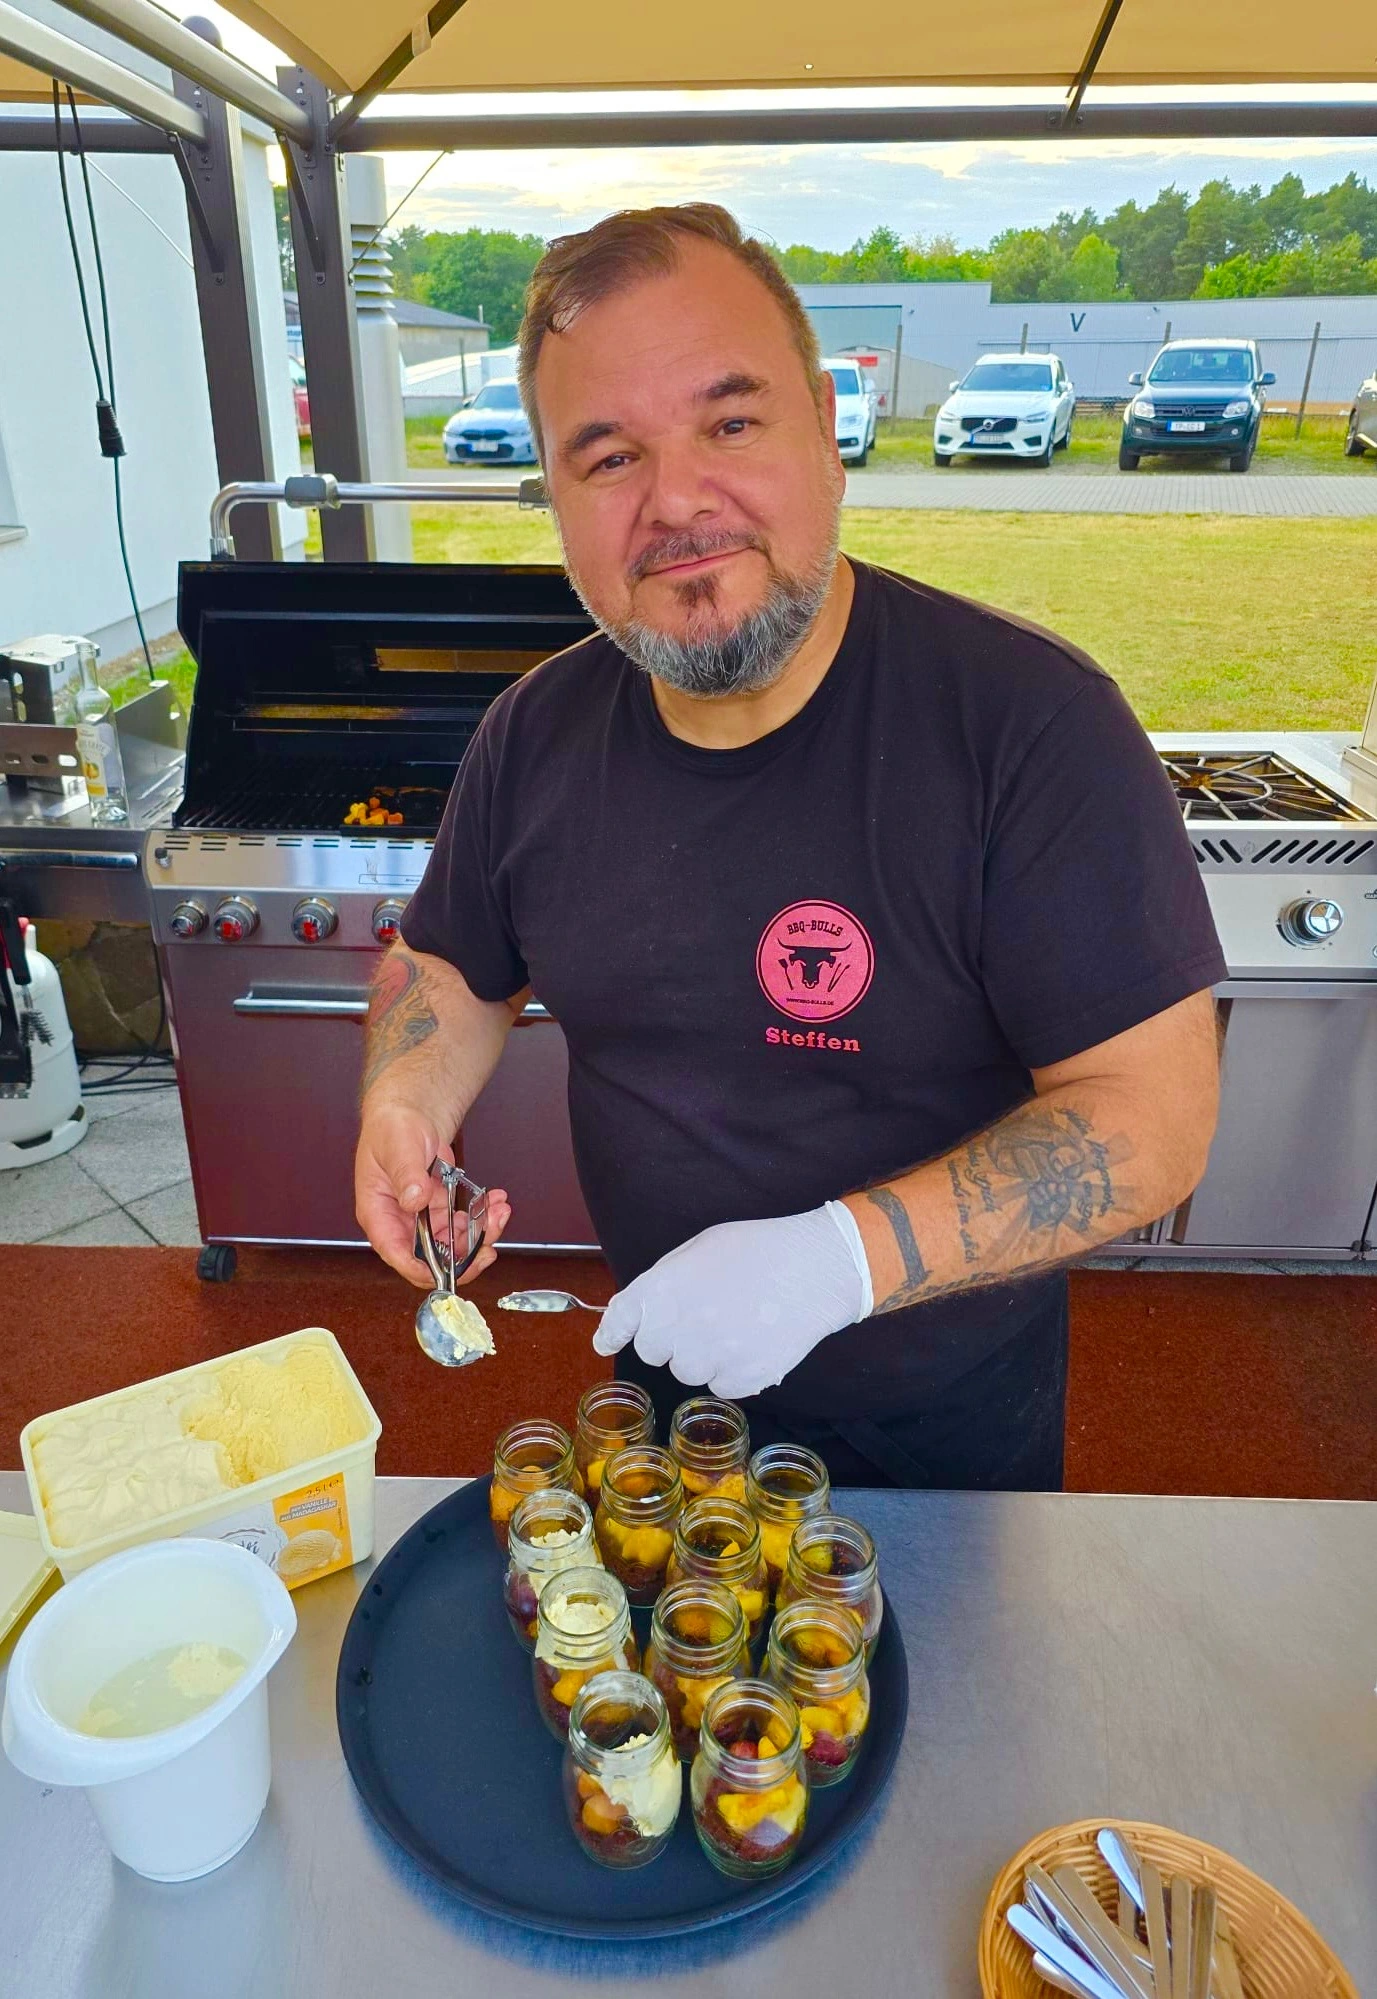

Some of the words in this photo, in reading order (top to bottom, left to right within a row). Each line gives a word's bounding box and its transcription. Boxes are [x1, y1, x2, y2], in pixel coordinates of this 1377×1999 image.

[1070, 312, 1087, 332] V
[787, 920, 843, 936] BBQ-BULLS
[765, 1026, 861, 1052] Steffen
